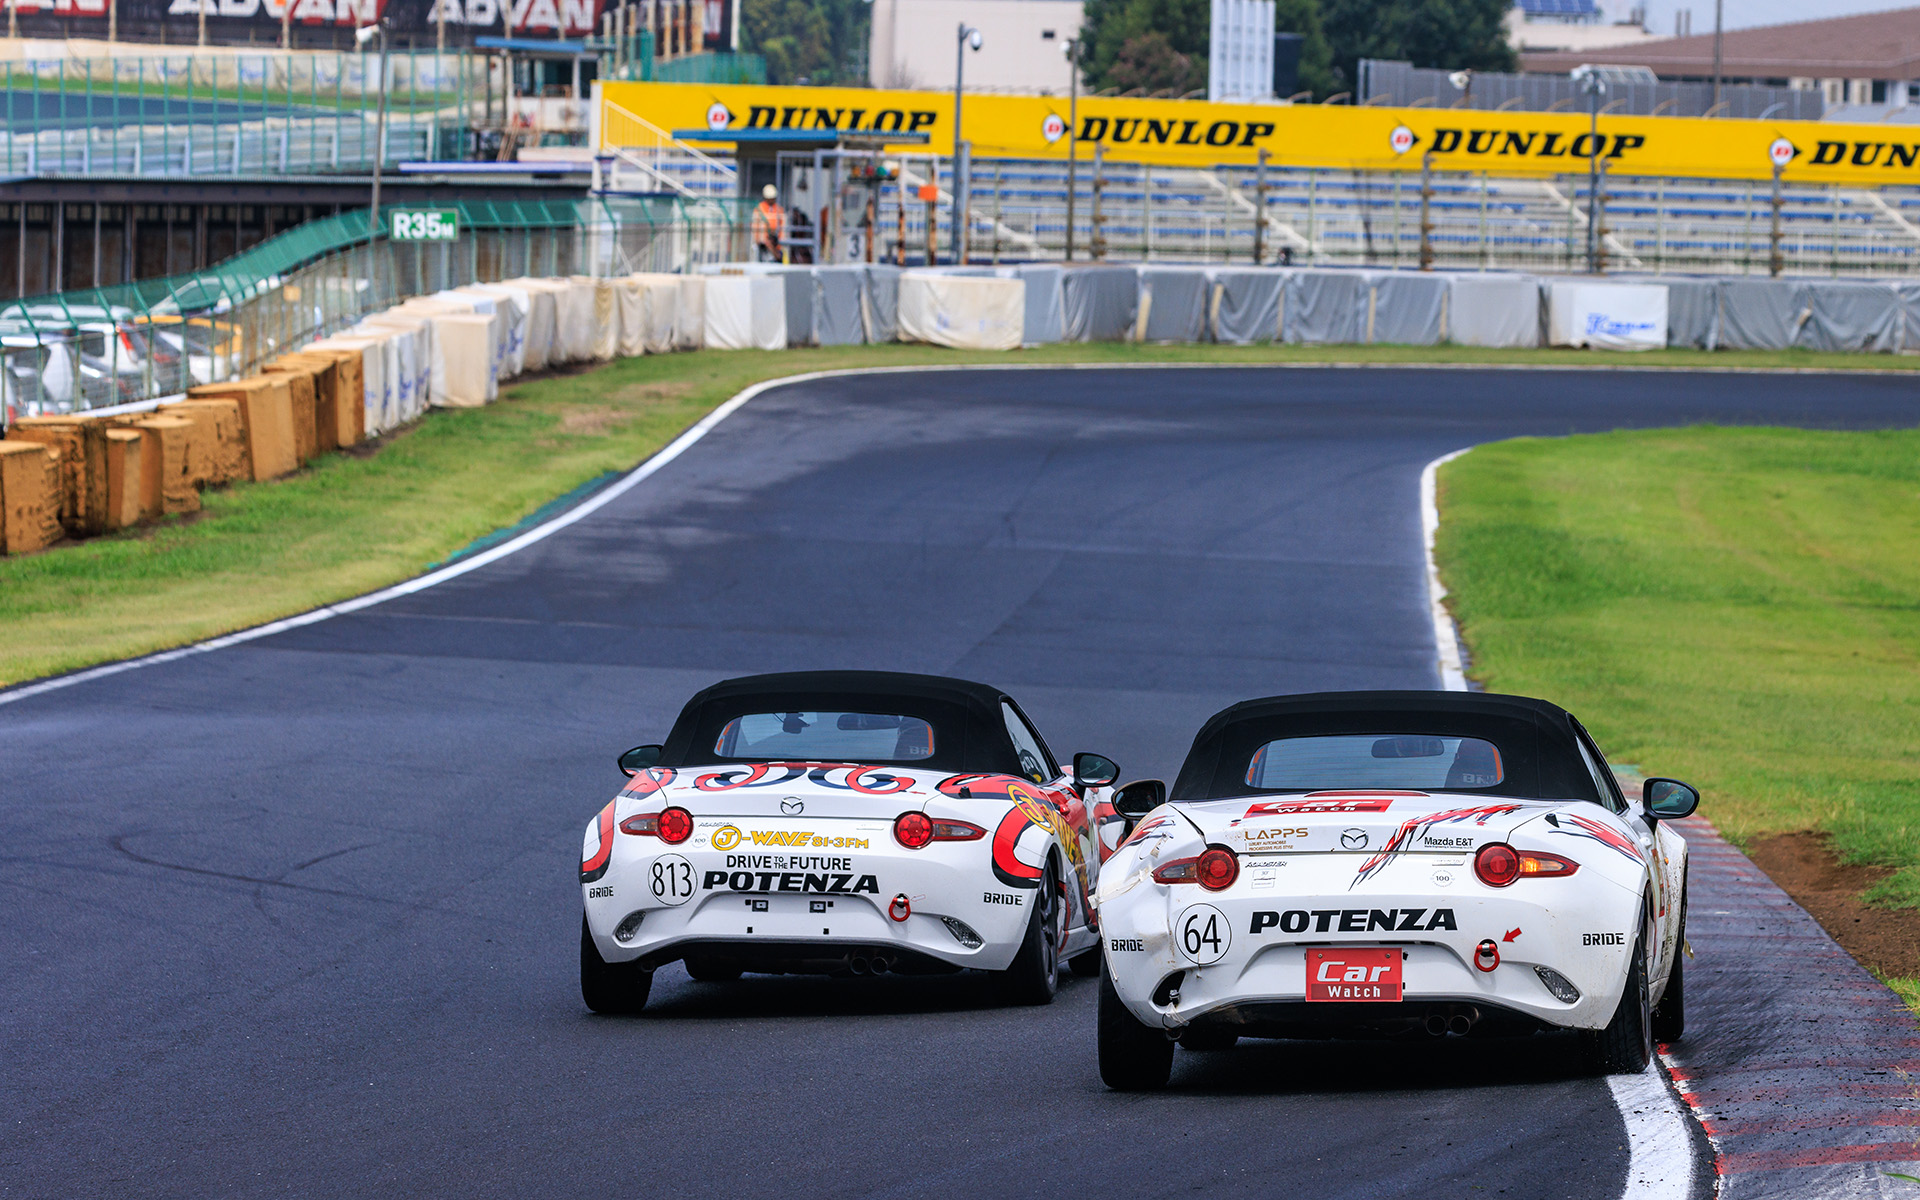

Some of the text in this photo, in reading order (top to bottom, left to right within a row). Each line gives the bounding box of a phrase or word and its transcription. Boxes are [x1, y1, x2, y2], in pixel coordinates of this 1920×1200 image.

[747, 106, 937, 131] DUNLOP
[1075, 117, 1275, 146] DUNLOP
[1427, 128, 1646, 158] DUNLOP
[849, 233, 860, 257] 3
[711, 825, 815, 851] J-WAVE
[1244, 827, 1309, 841] LAPPS
[1424, 836, 1474, 846] Mazda E&T
[726, 855, 772, 868] DRIVE
[789, 856, 852, 871] FUTURE
[652, 862, 693, 897] 813
[702, 870, 880, 894] POTENZA
[589, 886, 614, 899] BRIDE
[983, 891, 1023, 906] BRIDE
[1249, 908, 1458, 934] POTENZA
[1111, 939, 1144, 952] BRIDE
[1183, 913, 1222, 955] 64
[1582, 932, 1626, 946] BRIDE
[1316, 961, 1392, 983] Car
[1327, 985, 1381, 998] Watch
